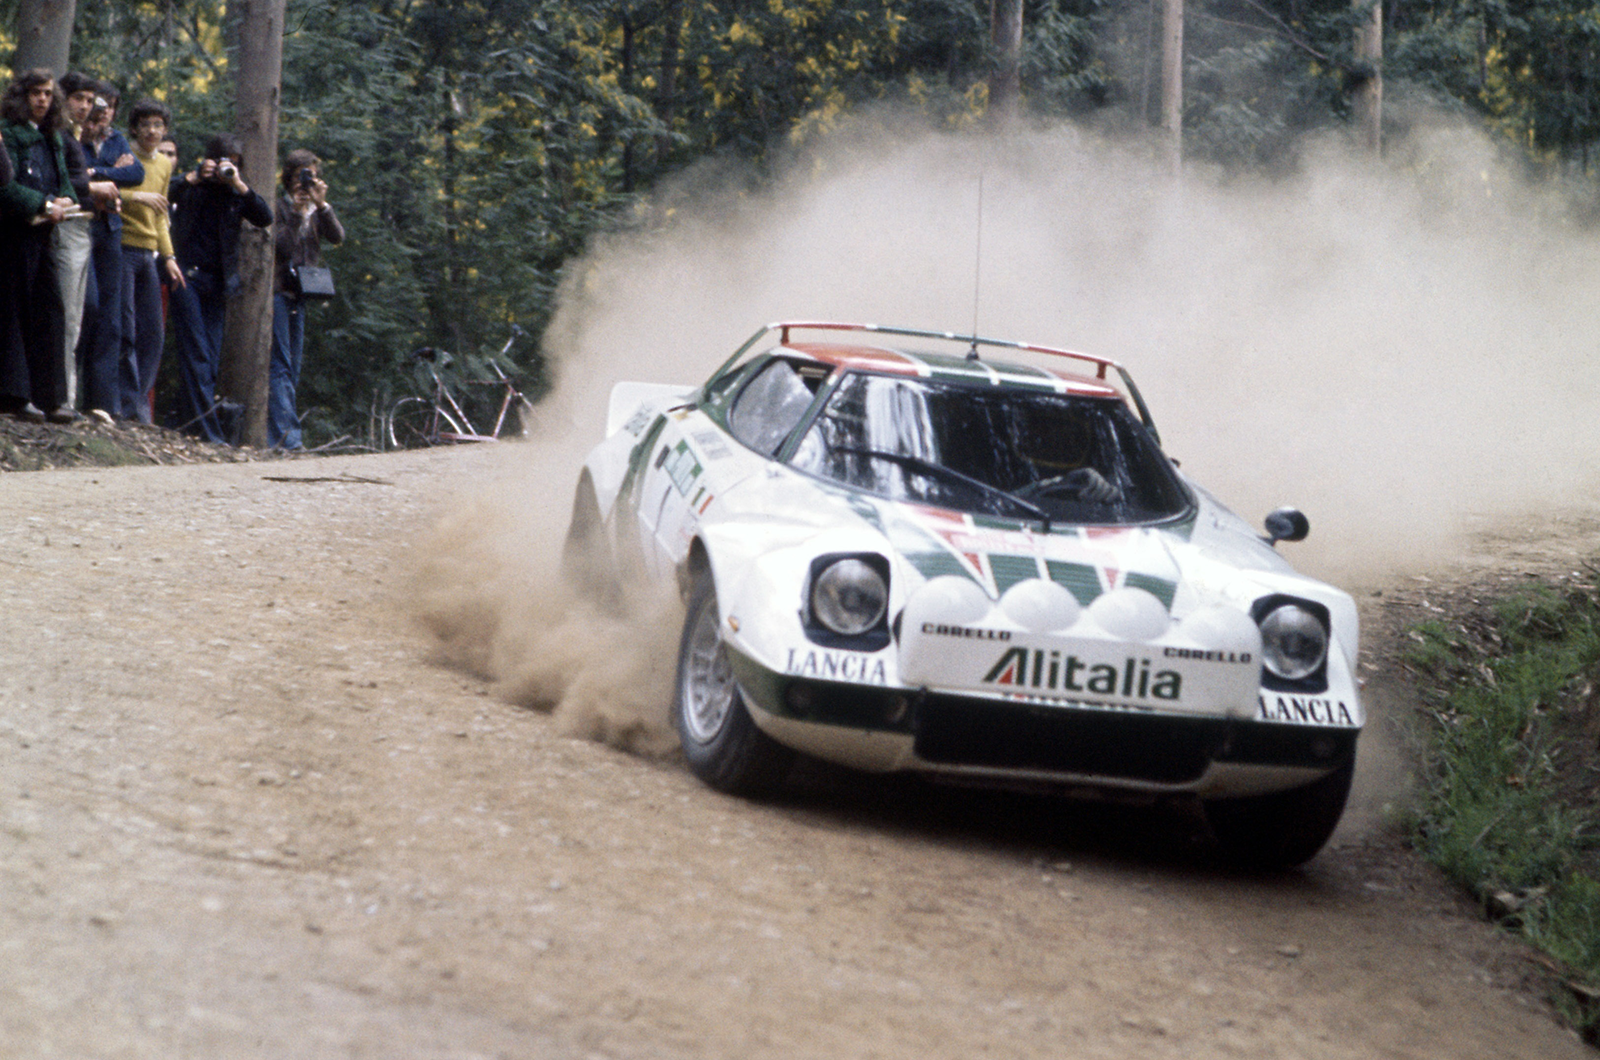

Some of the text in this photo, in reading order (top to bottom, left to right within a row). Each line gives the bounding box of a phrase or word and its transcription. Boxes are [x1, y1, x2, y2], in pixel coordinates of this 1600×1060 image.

[921, 622, 1011, 641] CARELLO
[786, 648, 886, 684] LANCIA
[1163, 647, 1252, 663] CARELLO
[983, 646, 1182, 700] Alitalia
[1258, 695, 1355, 726] LANCIA
